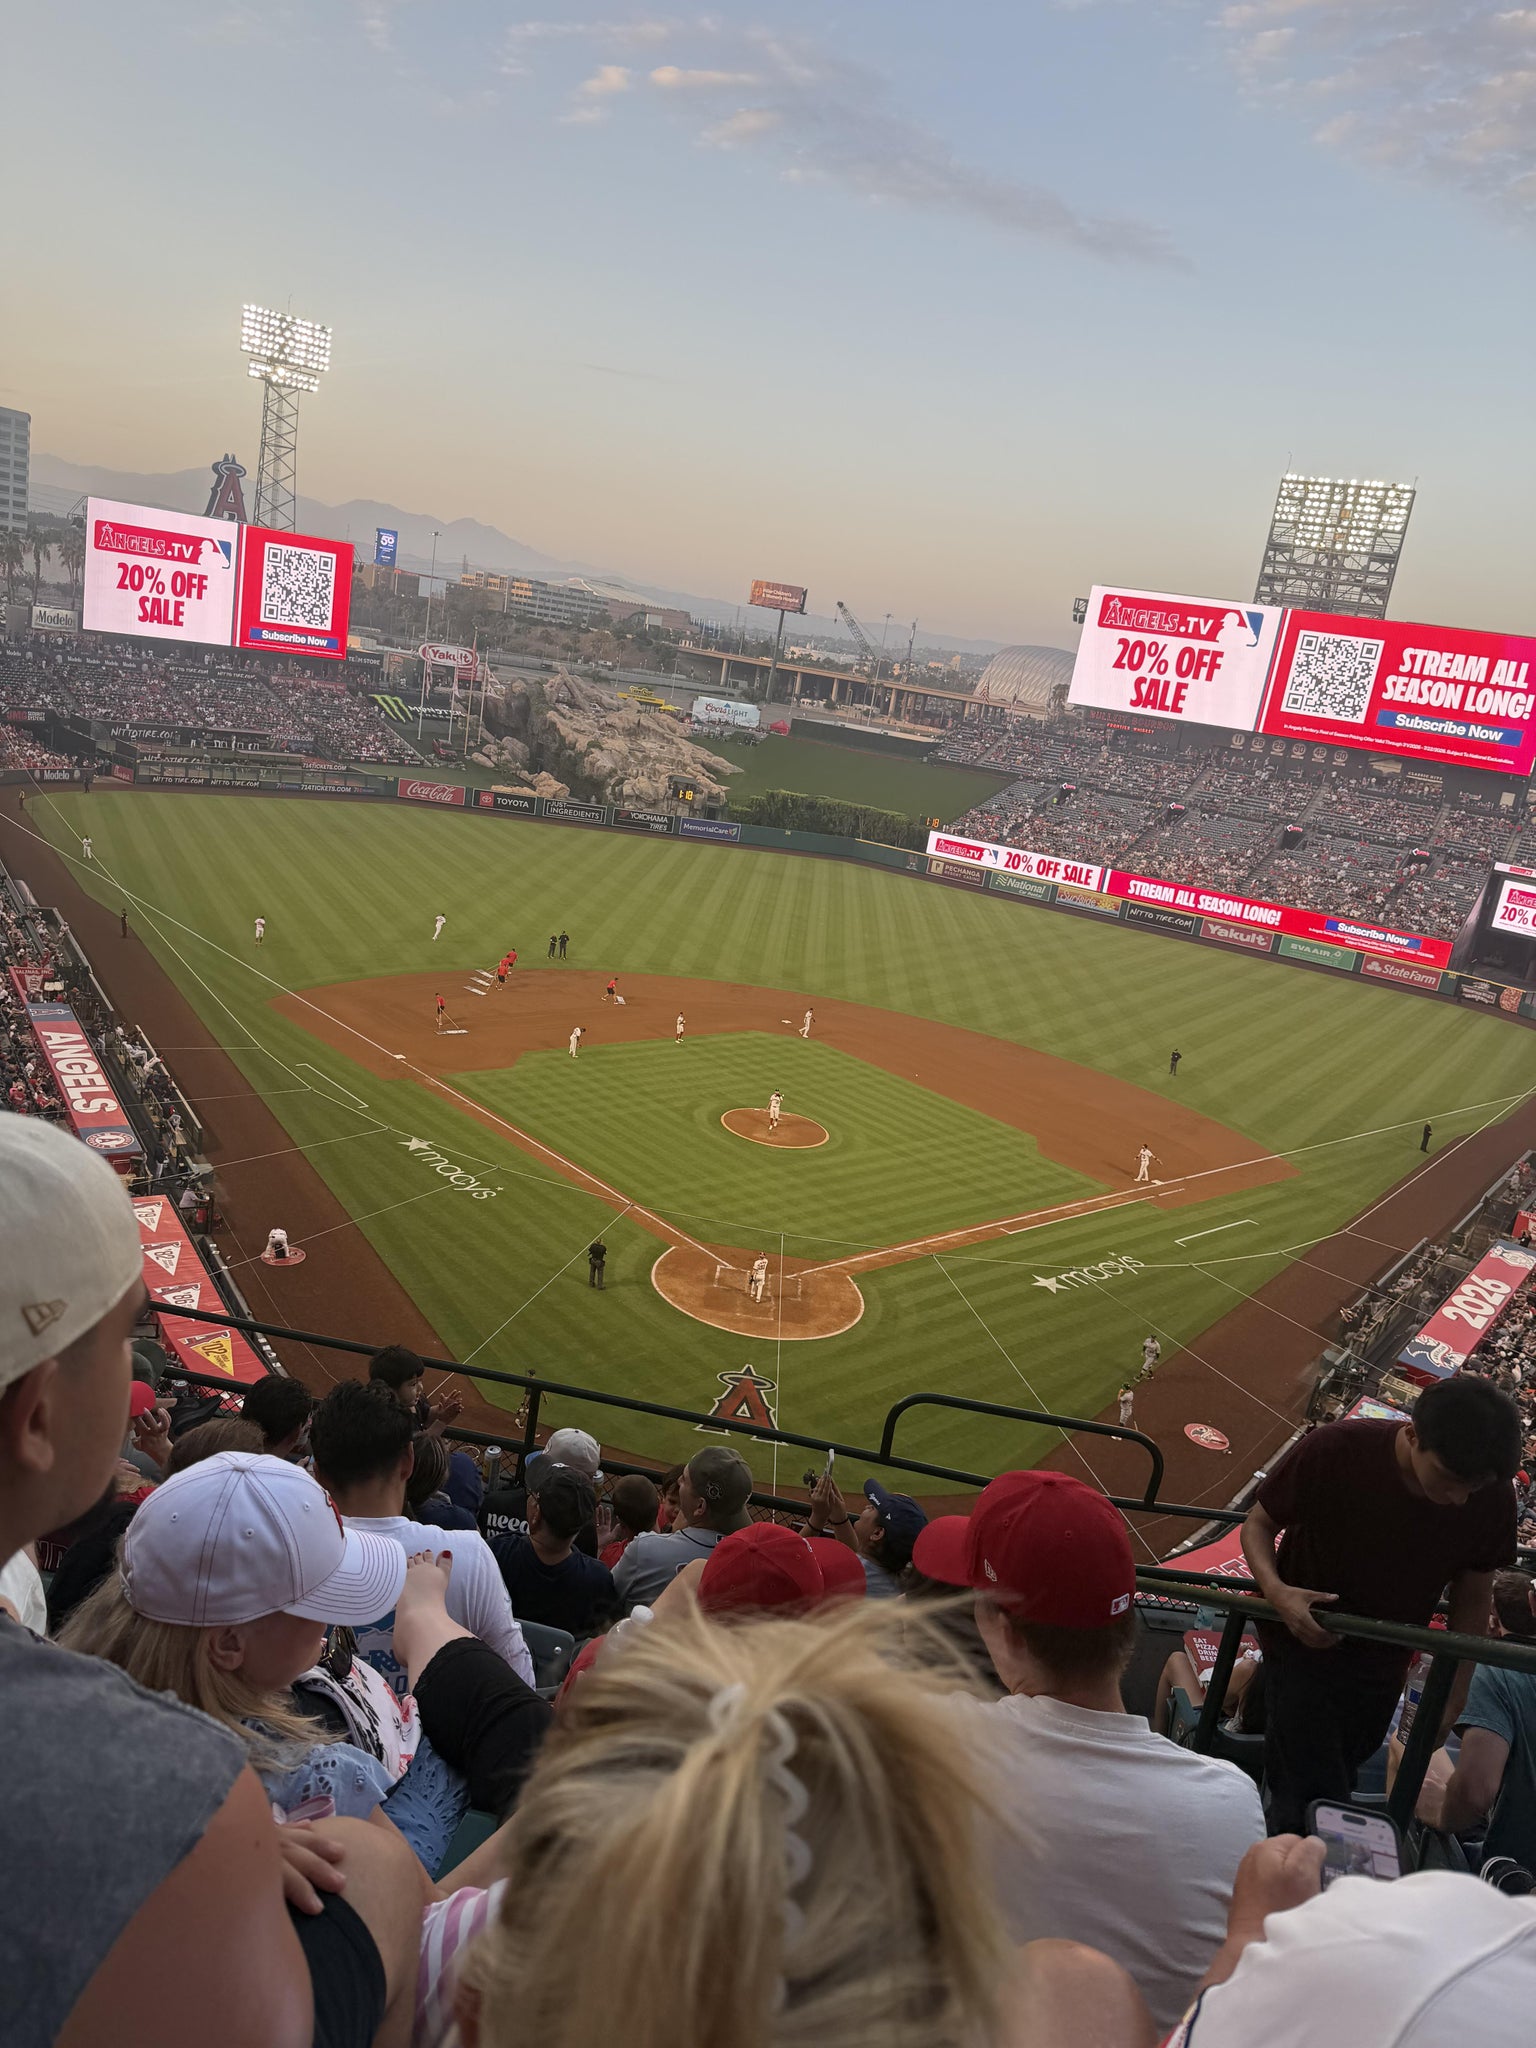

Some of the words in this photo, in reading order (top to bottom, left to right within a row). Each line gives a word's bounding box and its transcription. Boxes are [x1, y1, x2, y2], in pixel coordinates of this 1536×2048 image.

[117, 562, 165, 595] 20%
[171, 570, 208, 600] OFF
[39, 610, 73, 627] Modelo
[138, 596, 184, 627] SALE
[262, 630, 306, 644] Subscribe
[307, 635, 328, 647] Now
[430, 649, 470, 665] Yakult
[1112, 638, 1168, 675] 20%
[1175, 646, 1224, 682] OFF
[1398, 647, 1490, 684] STREAM
[1489, 659, 1529, 689] ALL
[1129, 676, 1189, 714] SALE
[1382, 675, 1464, 710] SEASON
[1463, 685, 1535, 721] LONG!
[705, 703, 727, 714] Coors
[727, 709, 748, 718] LIGHT
[1395, 714, 1466, 735] Subscribe
[1468, 724, 1503, 741] Now
[44, 769, 70, 780] Modelo
[497, 797, 529, 808] TOYOTA
[551, 802, 567, 810] JUST
[550, 806, 600, 822] INGREDIENTS
[630, 811, 668, 824] YOKOHAMA
[649, 823, 668, 832] TIRES
[683, 823, 729, 835] MemorialCare
[945, 865, 980, 878] PECHANGA
[1004, 852, 1033, 873] 20%
[1036, 859, 1061, 879] OFF
[1062, 864, 1093, 886] SALE
[1007, 878, 1047, 894] National
[1128, 879, 1175, 903] STREAM
[1175, 890, 1195, 908] ALL
[1197, 894, 1243, 917] SEASON
[1242, 904, 1283, 926] LONG!
[1129, 908, 1154, 920] NITTO
[1156, 915, 1192, 928] TIRE.COM
[1499, 905, 1529, 926] 20%
[1207, 923, 1268, 946] Yakult
[1337, 922, 1385, 941] Subscribe
[1385, 931, 1411, 946] Now
[40, 1030, 118, 1114] ANGELS
[1441, 1273, 1512, 1330] 2026
[201, 1340, 228, 1357] '02
[693, 1363, 790, 1446] A
[1195, 1643, 1219, 1651] PIZZA
